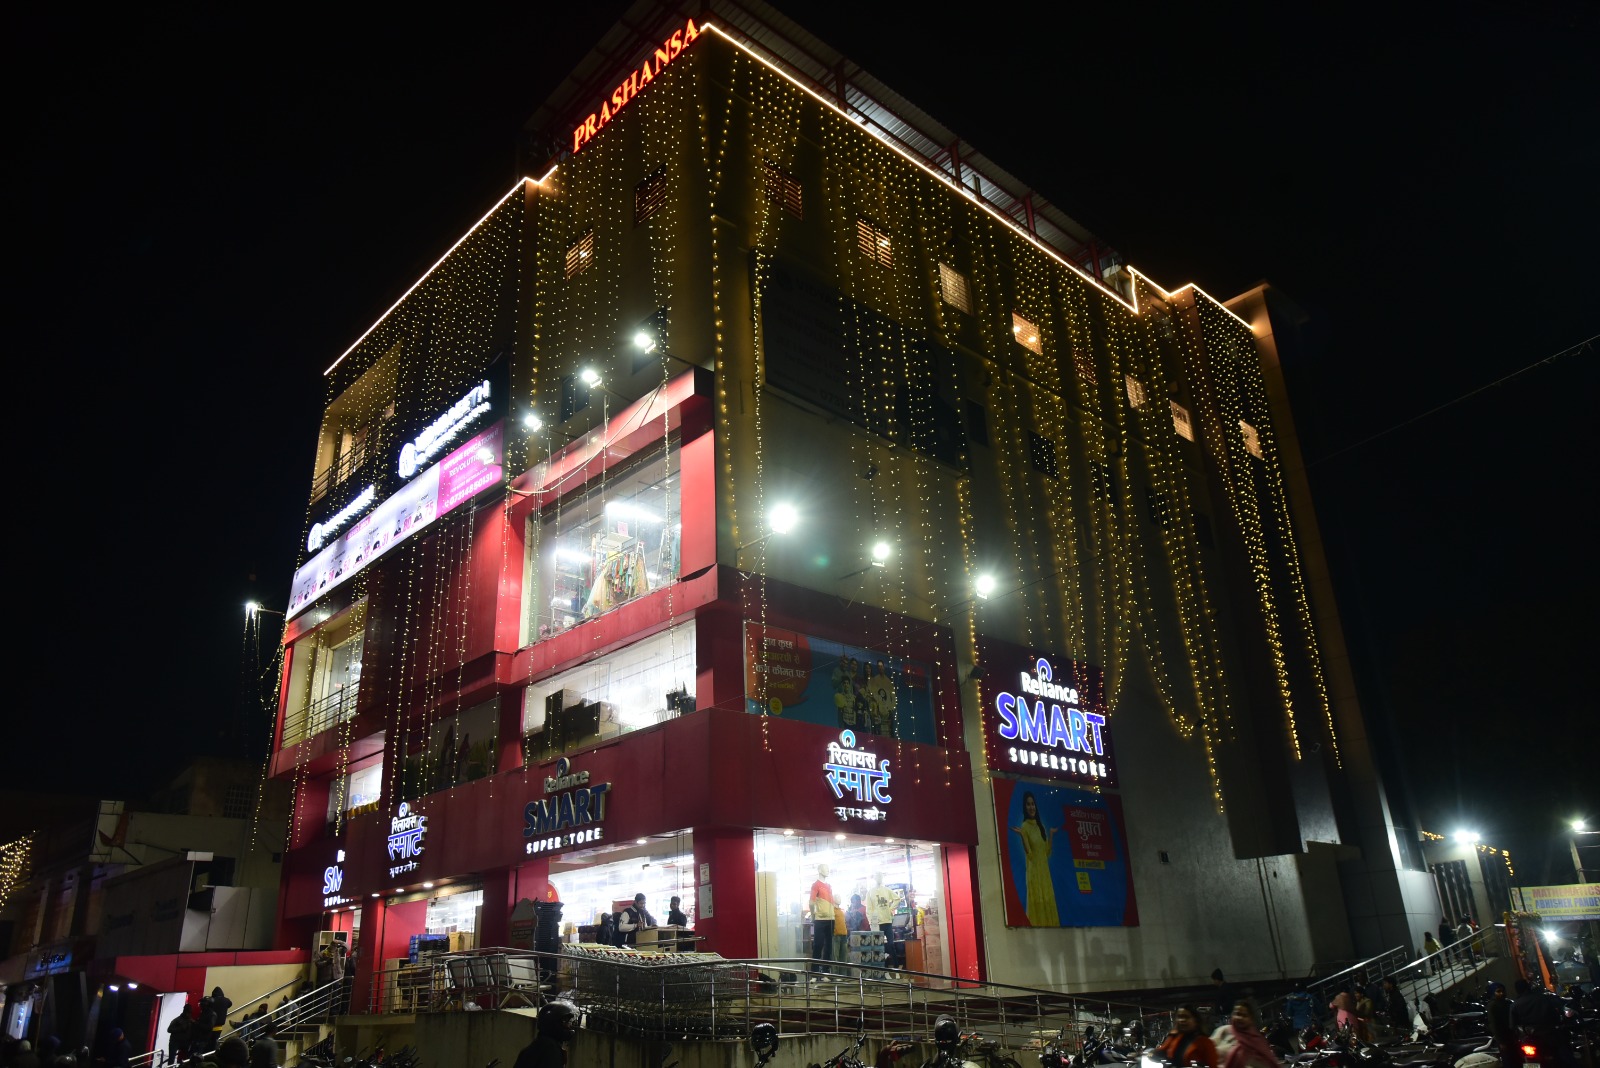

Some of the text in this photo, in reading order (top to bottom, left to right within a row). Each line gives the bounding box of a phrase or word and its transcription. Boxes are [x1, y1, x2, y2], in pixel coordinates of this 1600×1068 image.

[572, 18, 700, 153] PRASHANSA
[1021, 671, 1079, 704] Reliance
[996, 692, 1106, 756] SMART
[1008, 747, 1107, 777] SUPERSTORE
[543, 770, 590, 794] Reliance
[823, 759, 892, 804] स्मार्ट
[523, 782, 612, 837] SMART
[526, 827, 604, 854] SUPERSTORE
[1533, 886, 1600, 898] MATHEMATICS
[1535, 899, 1573, 909] ABHISHEK
